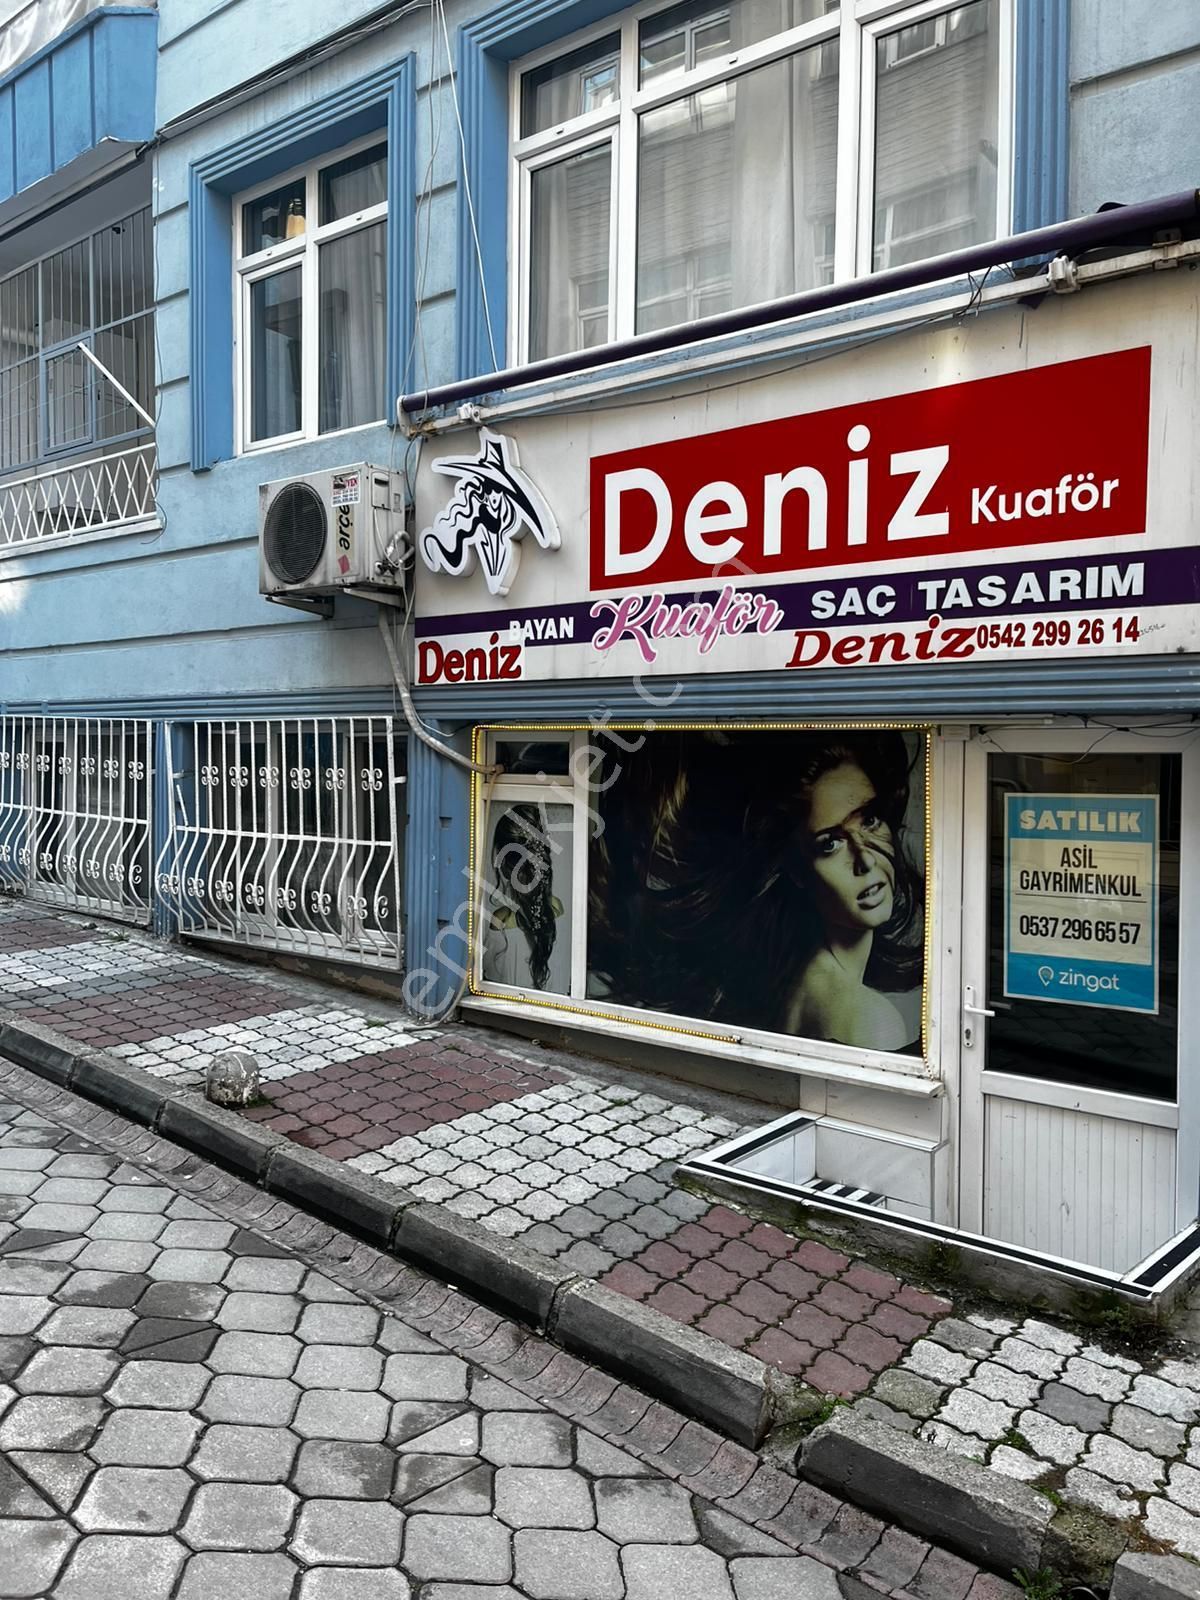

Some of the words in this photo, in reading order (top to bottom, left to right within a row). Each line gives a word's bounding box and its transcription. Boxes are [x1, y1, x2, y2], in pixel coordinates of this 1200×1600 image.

[604, 424, 950, 577] Deniz
[971, 472, 1119, 525] Kuaför
[509, 617, 574, 641] BAYAN
[590, 584, 784, 664] Kuaför
[810, 585, 896, 619] SAÇ
[918, 562, 1145, 611] TASARIM
[785, 614, 978, 667] Deniz
[977, 620, 1026, 649] 0542
[1032, 619, 1071, 647] 299
[1077, 617, 1104, 644] 26
[1112, 615, 1140, 643] 14
[418, 632, 522, 684] Deniz
[1019, 809, 1142, 833] SATILIK
[1060, 844, 1098, 869] ASİL
[1020, 868, 1142, 897] GAYRİMENKUL
[1019, 915, 1059, 938] 0537
[1062, 918, 1092, 940] 296
[1094, 921, 1116, 943] 65
[1119, 923, 1141, 945] 57
[1059, 968, 1120, 992] zingat
